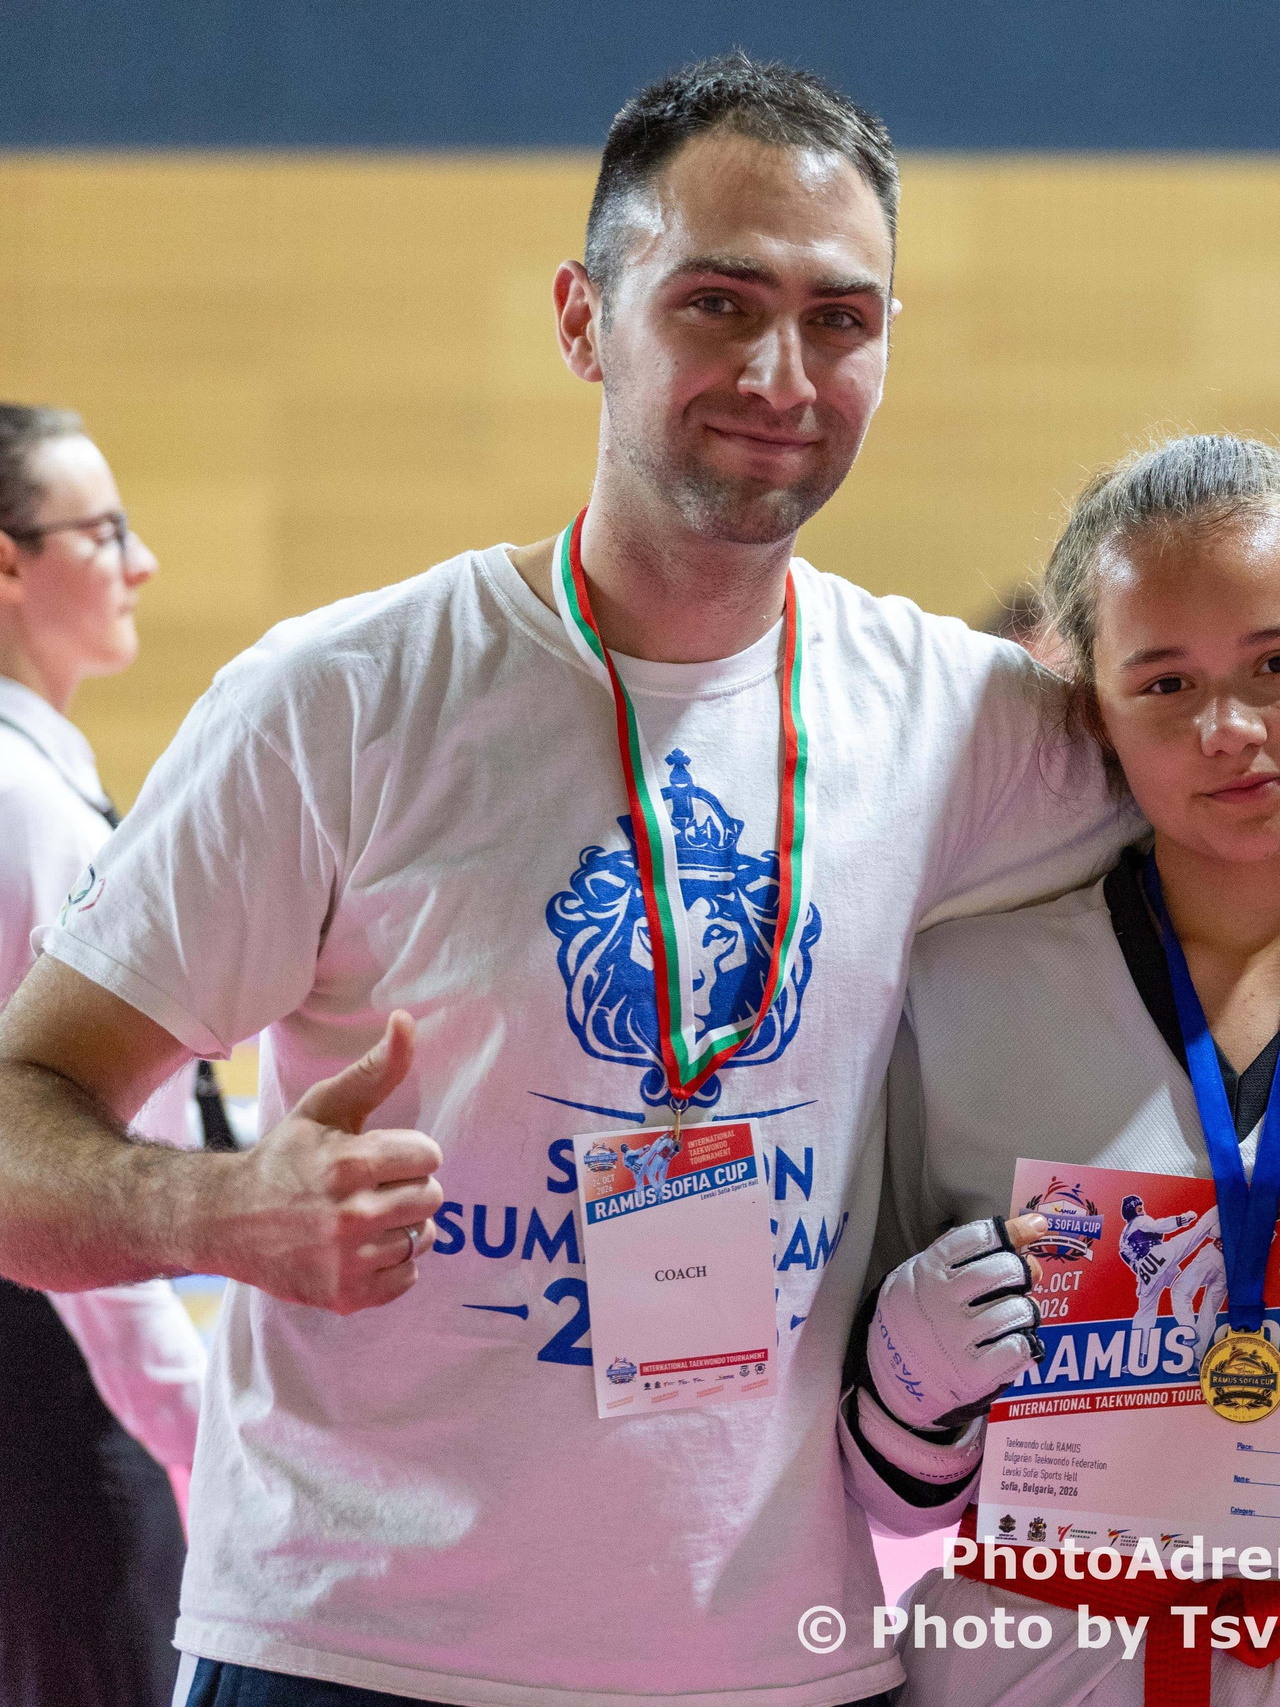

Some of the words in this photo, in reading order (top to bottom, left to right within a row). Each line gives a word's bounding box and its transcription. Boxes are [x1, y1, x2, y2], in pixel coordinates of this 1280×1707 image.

[688, 1130, 736, 1149] INTERNATIONAL
[689, 1141, 728, 1156] TAEKWONDO
[690, 1148, 731, 1165] TOURNAMENT
[594, 1187, 656, 1220] RAMUS
[661, 1172, 711, 1200] SOFIA
[714, 1162, 748, 1185] CUP
[731, 1181, 748, 1192] Sports
[1055, 1218, 1080, 1232] SOFIA
[1083, 1221, 1101, 1234] CUP
[654, 1265, 707, 1282] COACH
[1138, 1253, 1166, 1286] BUL
[1027, 1270, 1083, 1295] 4.OCT
[1039, 1298, 1069, 1319] 026
[642, 1363, 688, 1374] INTERNATIONAL
[689, 1358, 726, 1369] TAEKWONDO
[727, 1352, 765, 1364] TOURNAMENT
[1213, 1376, 1237, 1384] RAMUS
[1239, 1377, 1259, 1385] SOFIA
[1260, 1378, 1274, 1386] CUP
[1008, 1399, 1091, 1417] INTERNATIONAL
[1095, 1391, 1168, 1409] TAEKWONDO
[1006, 1437, 1039, 1450] Taekwondo
[1041, 1440, 1054, 1451] club
[1056, 1442, 1081, 1453] RAMUS
[1004, 1451, 1032, 1464] Bulgarian
[1035, 1453, 1069, 1466] Taekwondo
[1072, 1457, 1107, 1470] Federation
[1002, 1466, 1021, 1476] Levski
[1023, 1468, 1038, 1478] Sofia
[1041, 1469, 1061, 1481] Sports
[1064, 1472, 1078, 1482] Hall
[1001, 1481, 1020, 1493] Sofia,
[1023, 1483, 1056, 1496] Bulgaria,
[1059, 1486, 1078, 1497] 2026
